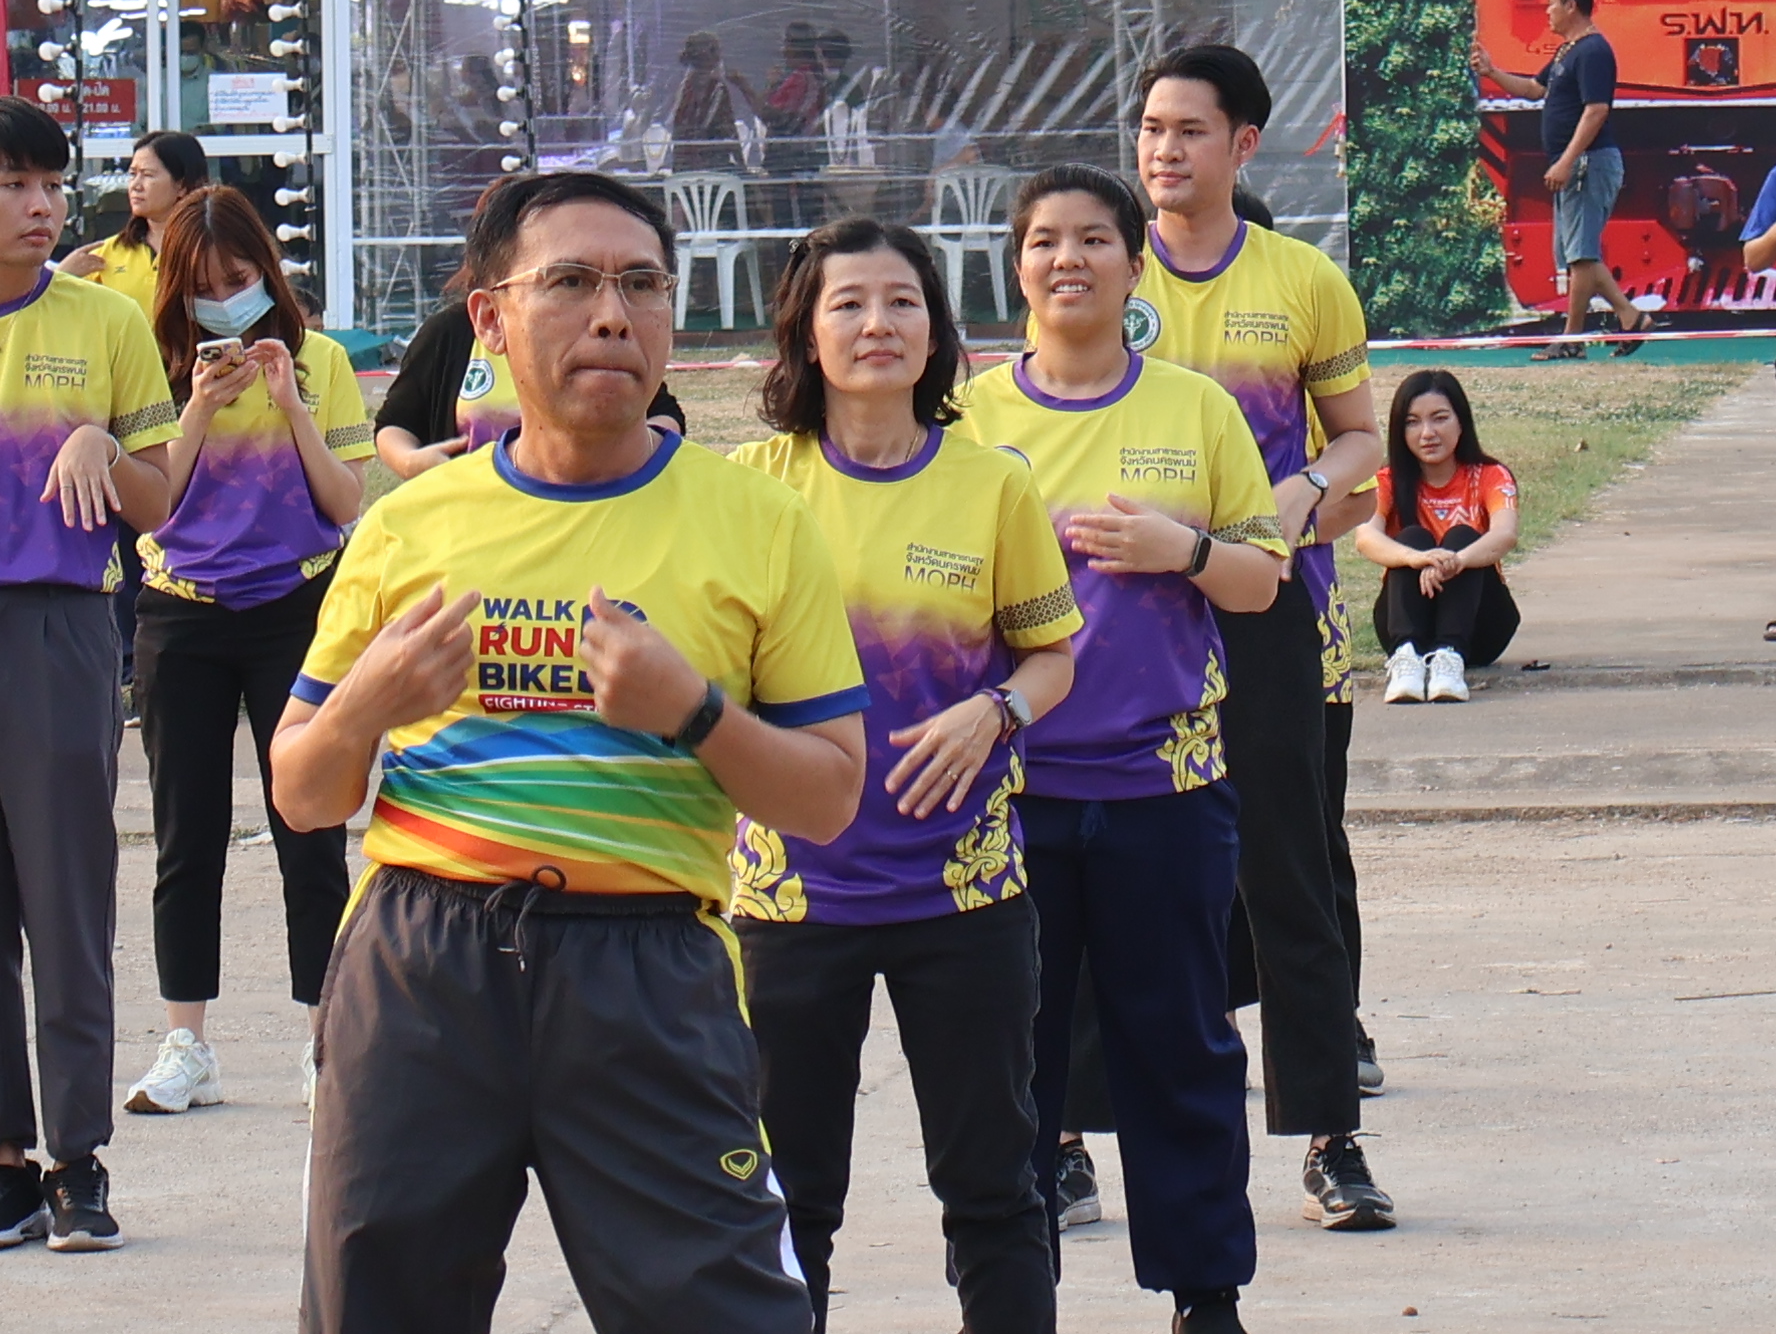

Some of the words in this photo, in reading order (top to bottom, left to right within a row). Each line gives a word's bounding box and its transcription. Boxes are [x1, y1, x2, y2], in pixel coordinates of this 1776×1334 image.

[1526, 43, 1558, 55] 45
[1224, 329, 1289, 347] MOPH
[25, 373, 86, 391] MOPH
[1120, 466, 1196, 486] MOPH
[904, 565, 976, 593] MOPH
[483, 598, 576, 621] WALK
[479, 623, 575, 658] RUN
[478, 662, 574, 693] BIKE
